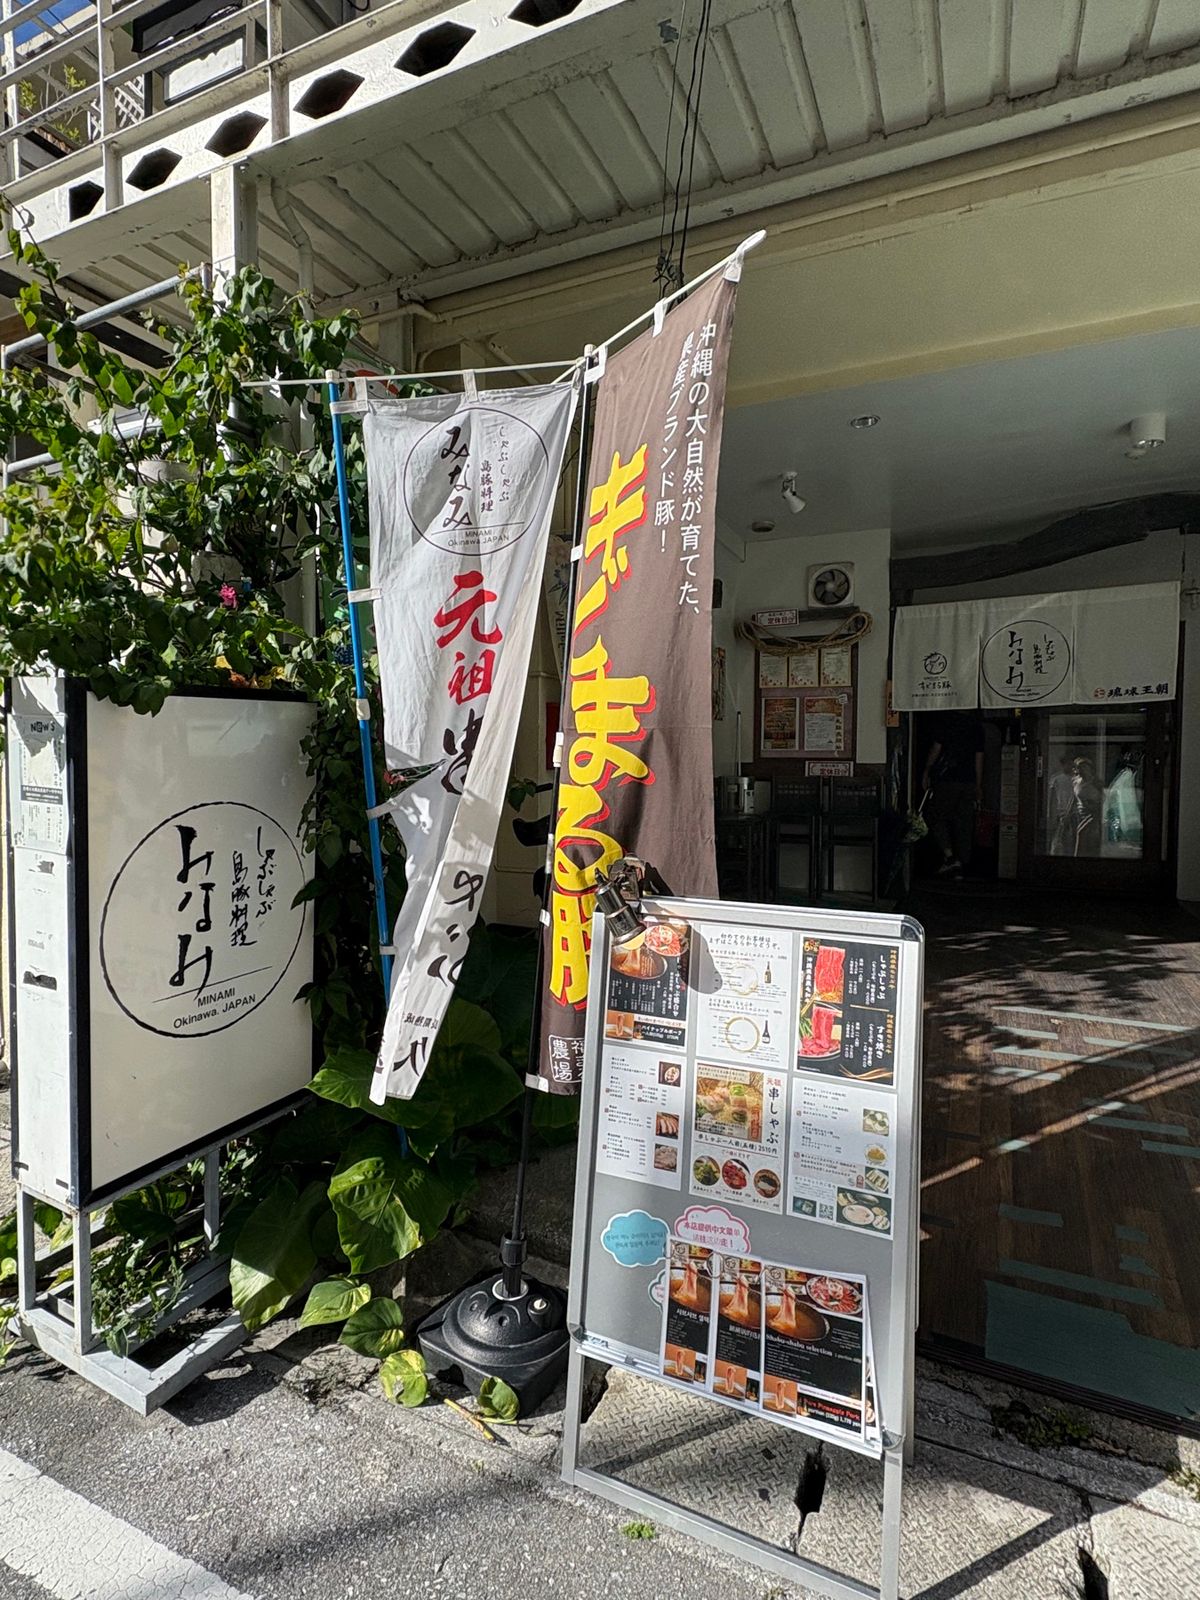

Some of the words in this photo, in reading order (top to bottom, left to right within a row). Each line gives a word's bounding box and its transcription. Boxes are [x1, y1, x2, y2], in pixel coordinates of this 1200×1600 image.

[440, 426, 472, 528] みなみ
[480, 460, 494, 513] 島豚料理
[678, 319, 716, 614] 沖縄の大自然が育てた、
[482, 534, 509, 544] JAPAN
[434, 570, 503, 705] 元祖
[1006, 631, 1023, 692] みなみ
[1107, 682, 1169, 698] 琉球王朝
[229, 850, 258, 946] 島豚料理
[256, 826, 276, 918] しゃぶしゃぶ
[169, 825, 216, 1000] みなみ
[197, 987, 236, 1008] MINAMI
[222, 994, 256, 1014] JAPAN
[877, 955, 886, 999] しゃぶしゃぶ
[552, 1040, 573, 1080] 農場
[875, 1025, 885, 1059] すき焼き
[767, 1087, 779, 1144] 串しゃぶ
